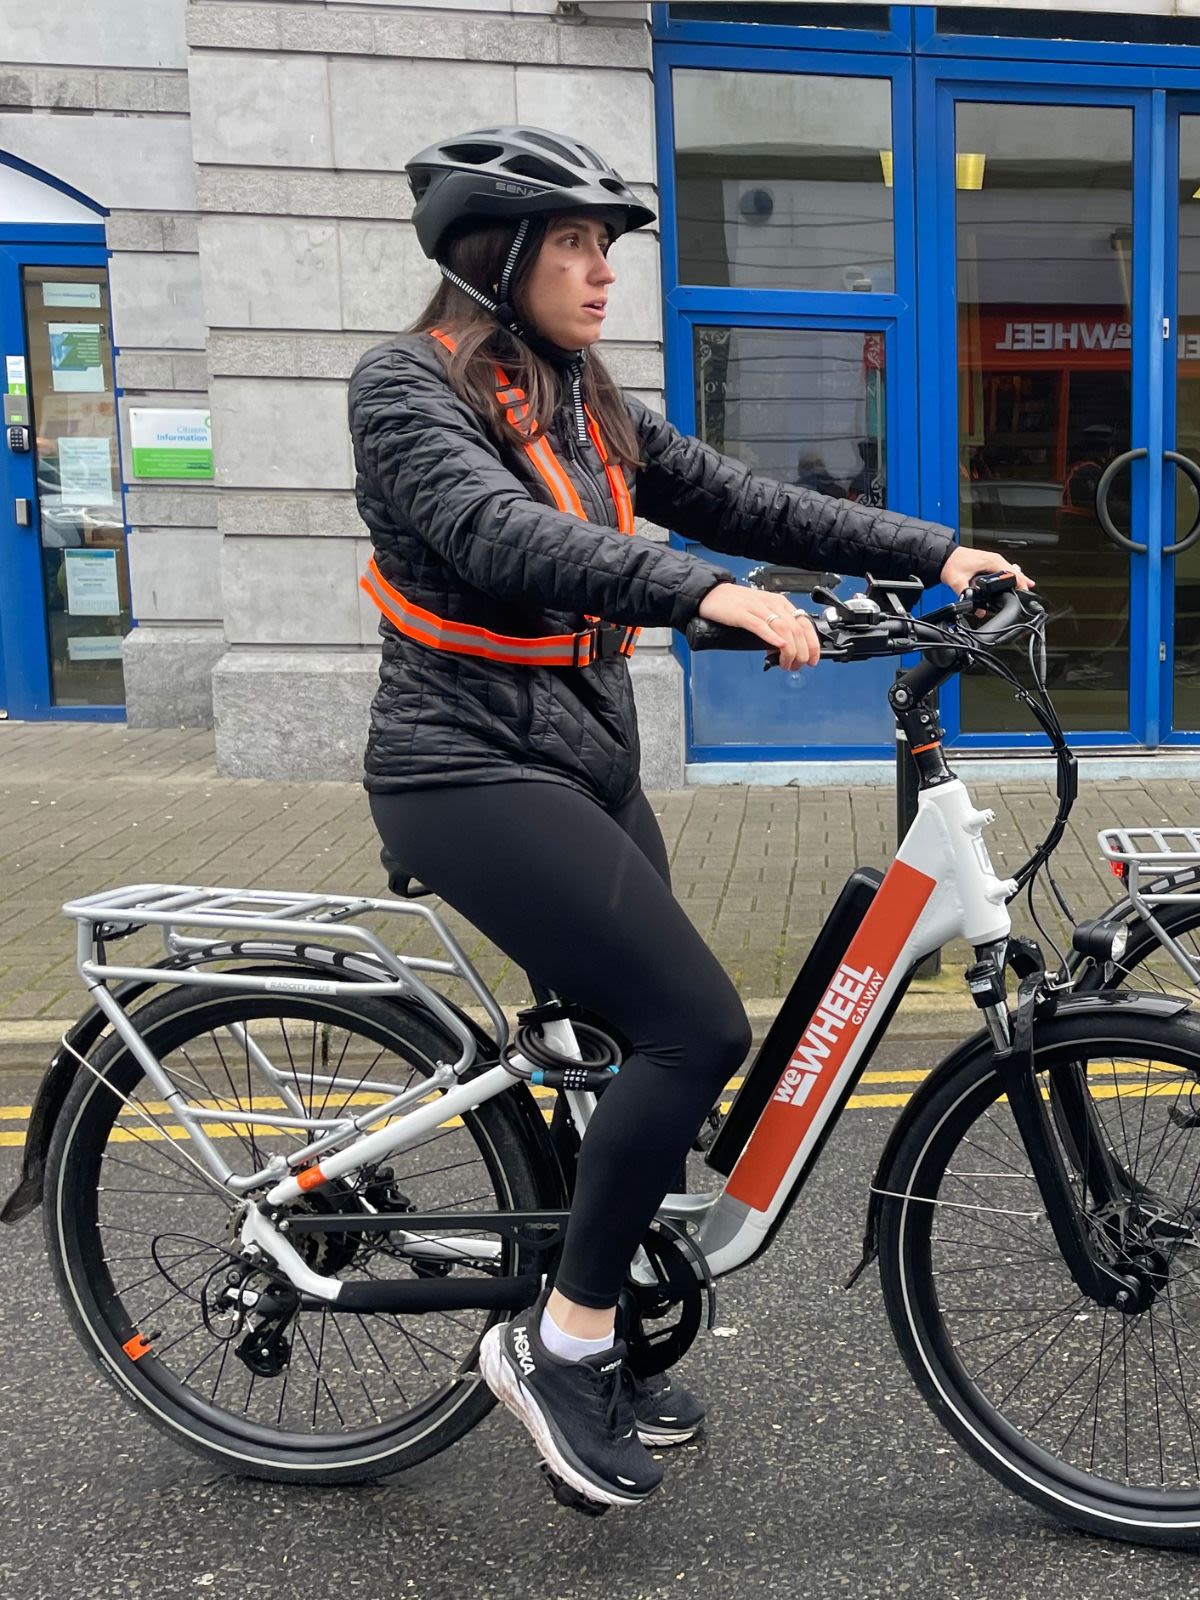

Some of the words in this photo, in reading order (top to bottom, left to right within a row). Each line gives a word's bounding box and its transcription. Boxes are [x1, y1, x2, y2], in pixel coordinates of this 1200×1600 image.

[496, 182, 534, 197] SENA
[157, 433, 208, 442] Information
[851, 971, 884, 1025] GALWAY
[513, 1326, 536, 1376] HOKA
